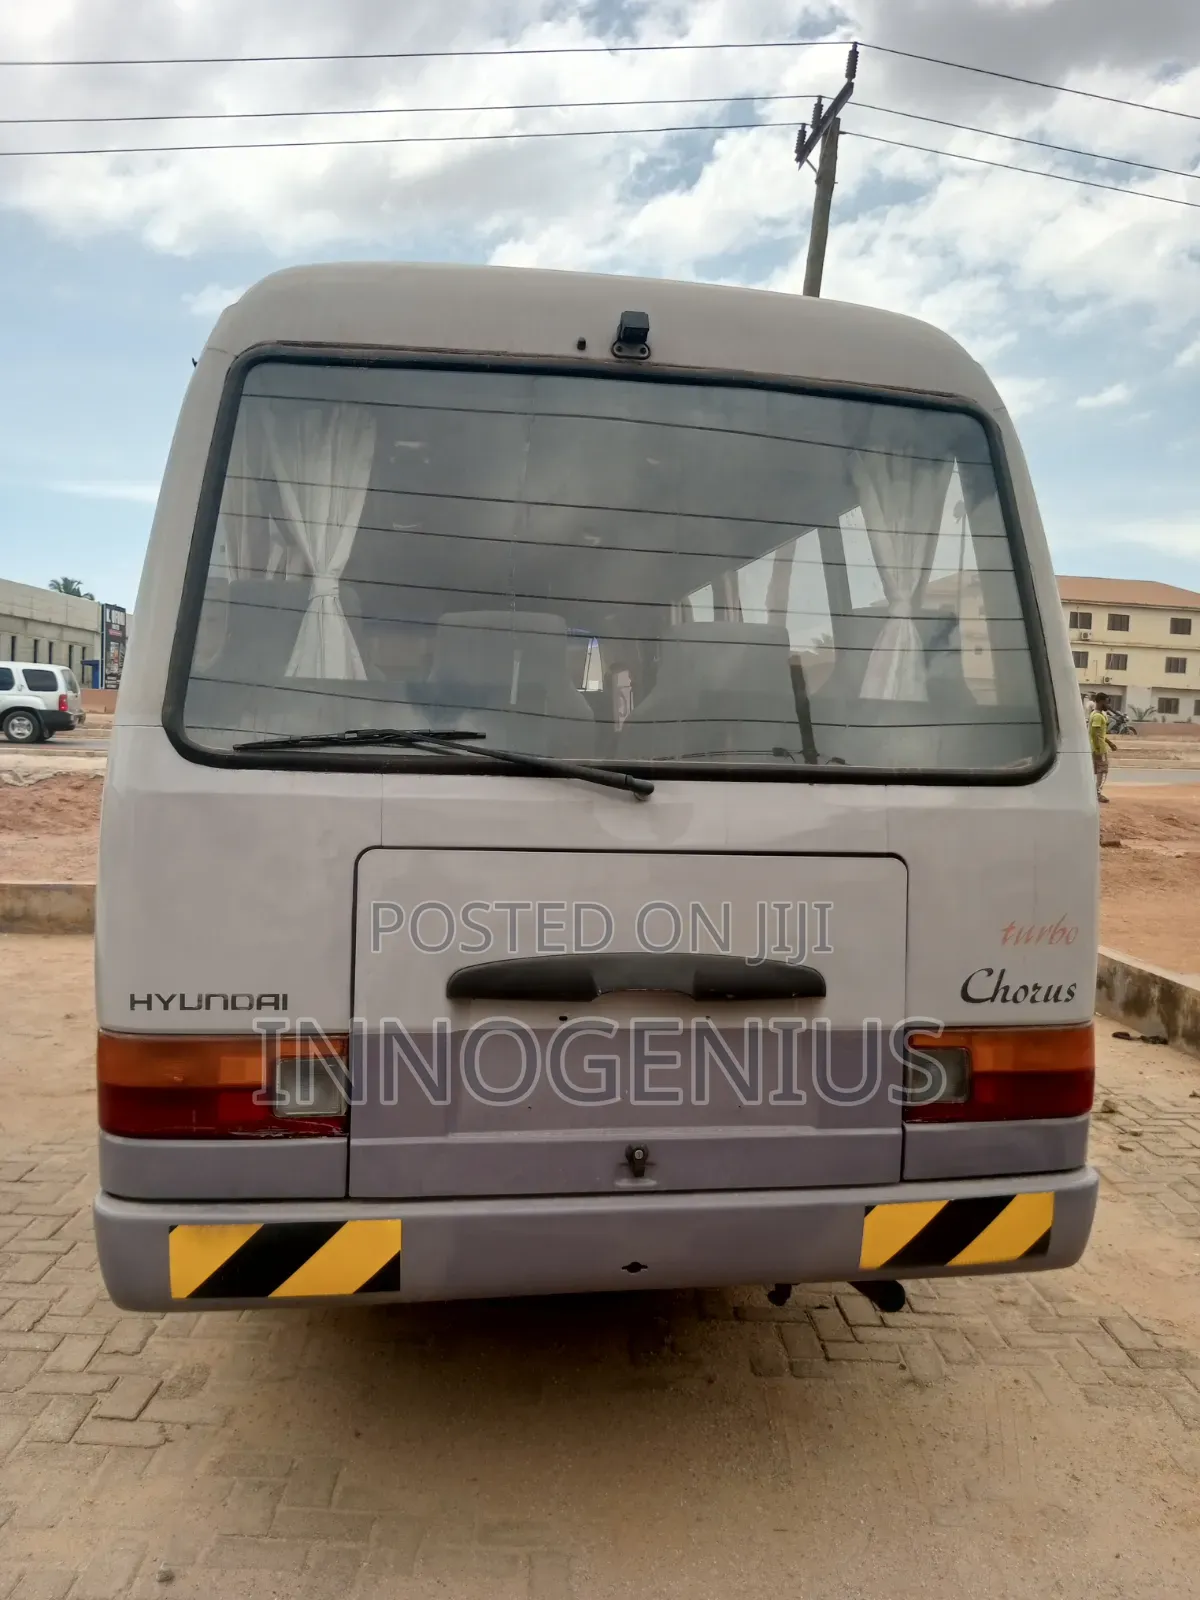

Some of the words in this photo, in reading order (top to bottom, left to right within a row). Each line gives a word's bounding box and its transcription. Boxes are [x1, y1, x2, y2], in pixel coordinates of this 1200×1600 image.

[1001, 912, 1079, 946] turbo
[129, 993, 288, 1011] HYUNDAI
[960, 967, 1077, 1004] Chorus
